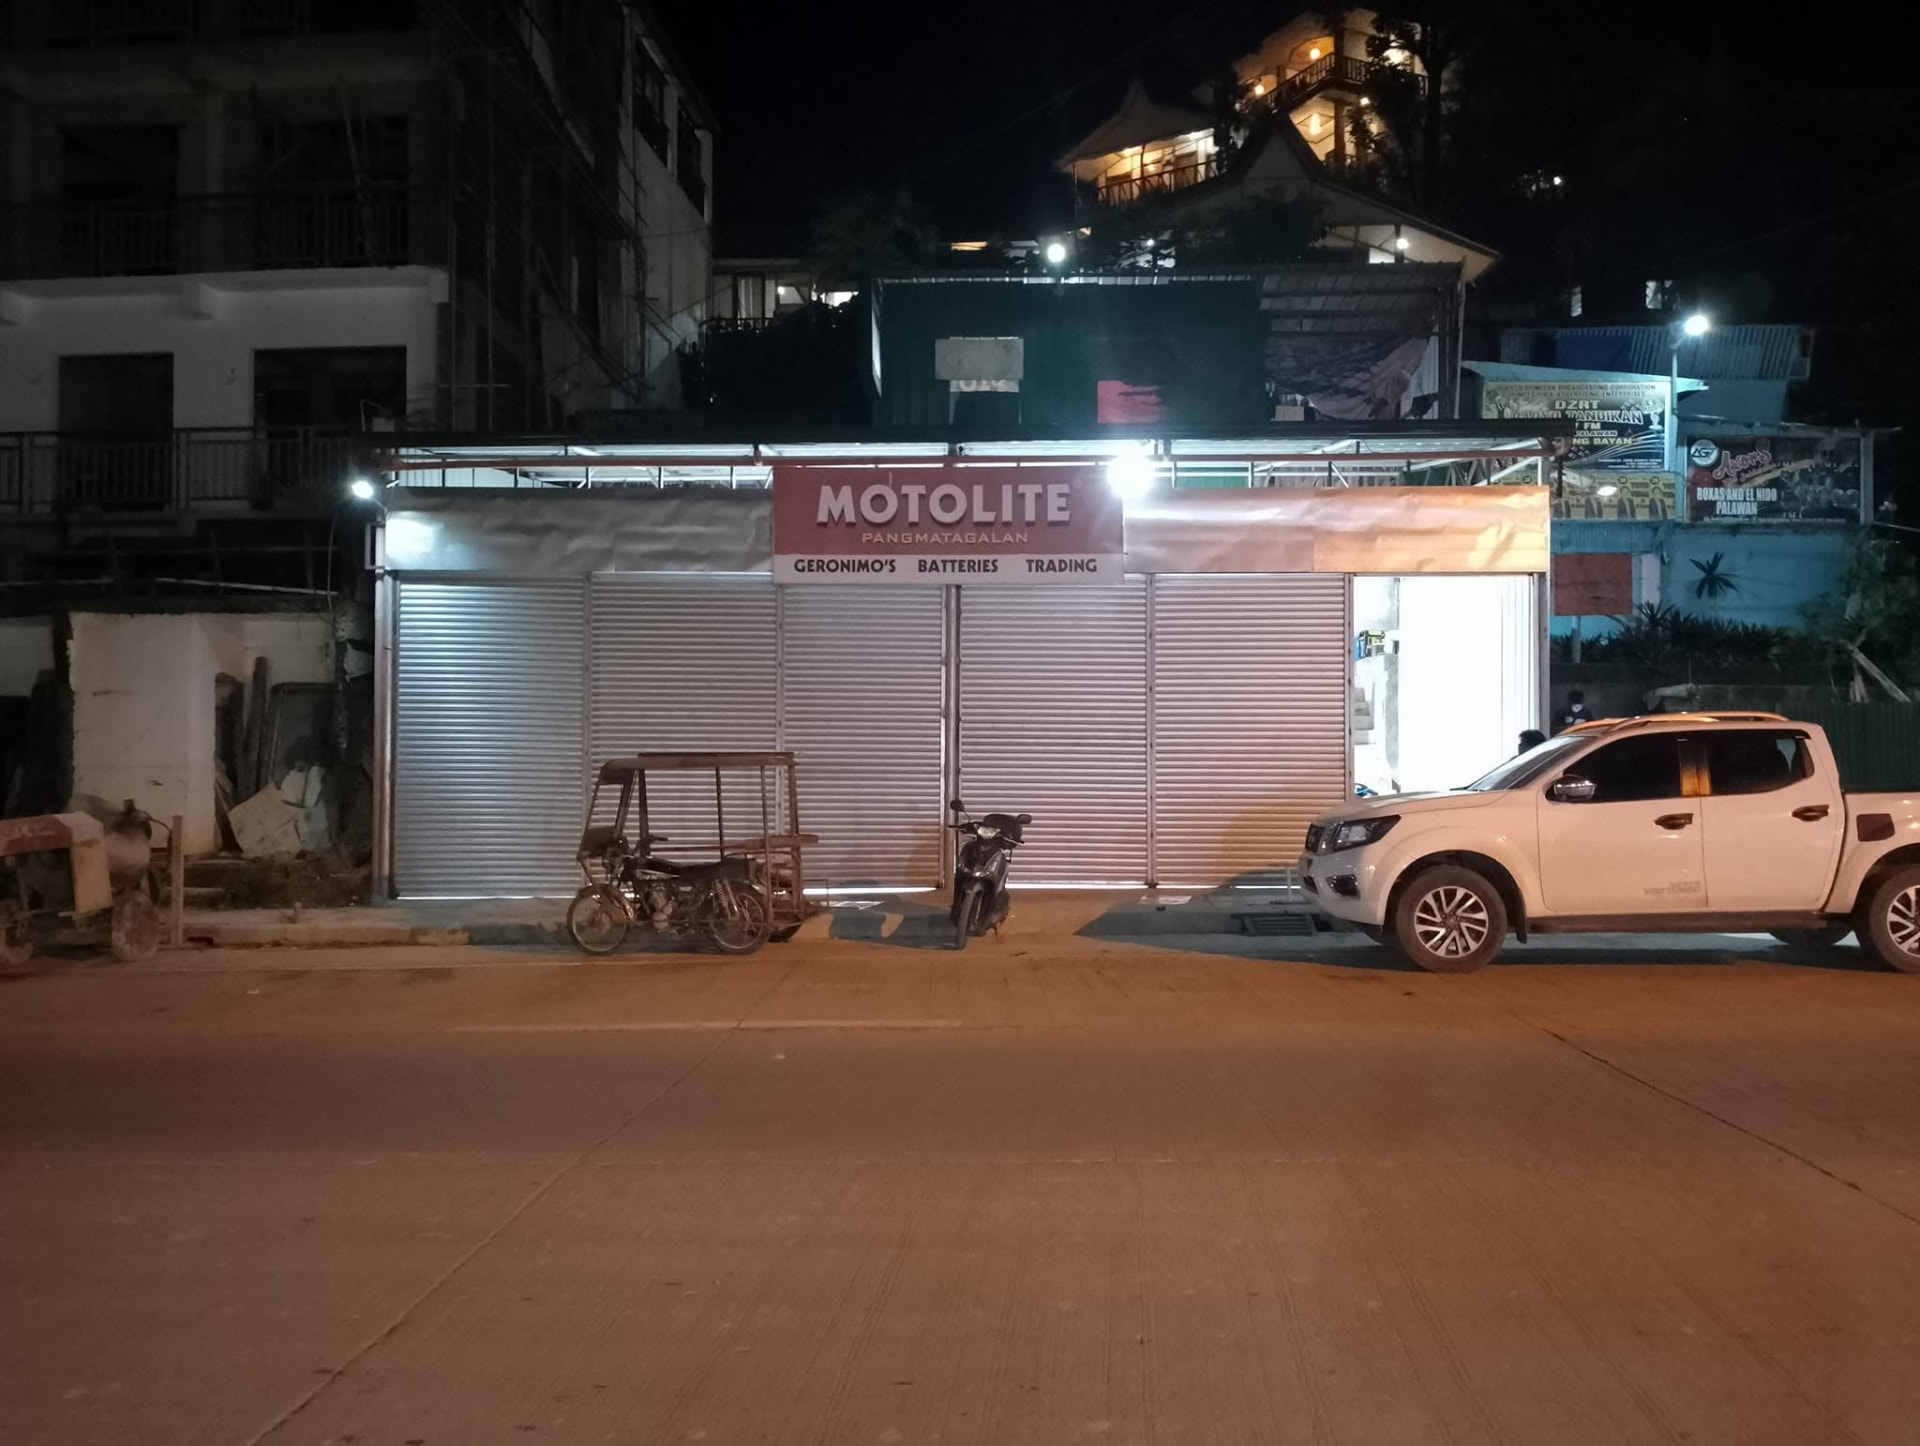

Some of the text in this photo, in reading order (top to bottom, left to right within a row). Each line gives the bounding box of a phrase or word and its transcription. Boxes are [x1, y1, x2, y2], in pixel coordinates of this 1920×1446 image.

[1565, 409, 1644, 425] TANDIKAN
[1583, 422, 1601, 430] FM
[1592, 437, 1633, 445] BAYAN
[1696, 487, 1778, 502] ROXAS AND EL NIDO
[816, 483, 1072, 525] MOTOLITE
[1716, 502, 1758, 515] PALAWAN
[861, 532, 1029, 545] PANGMATAGALAN
[793, 558, 1098, 574] GERONIMO'S BATTERIES TRADING
